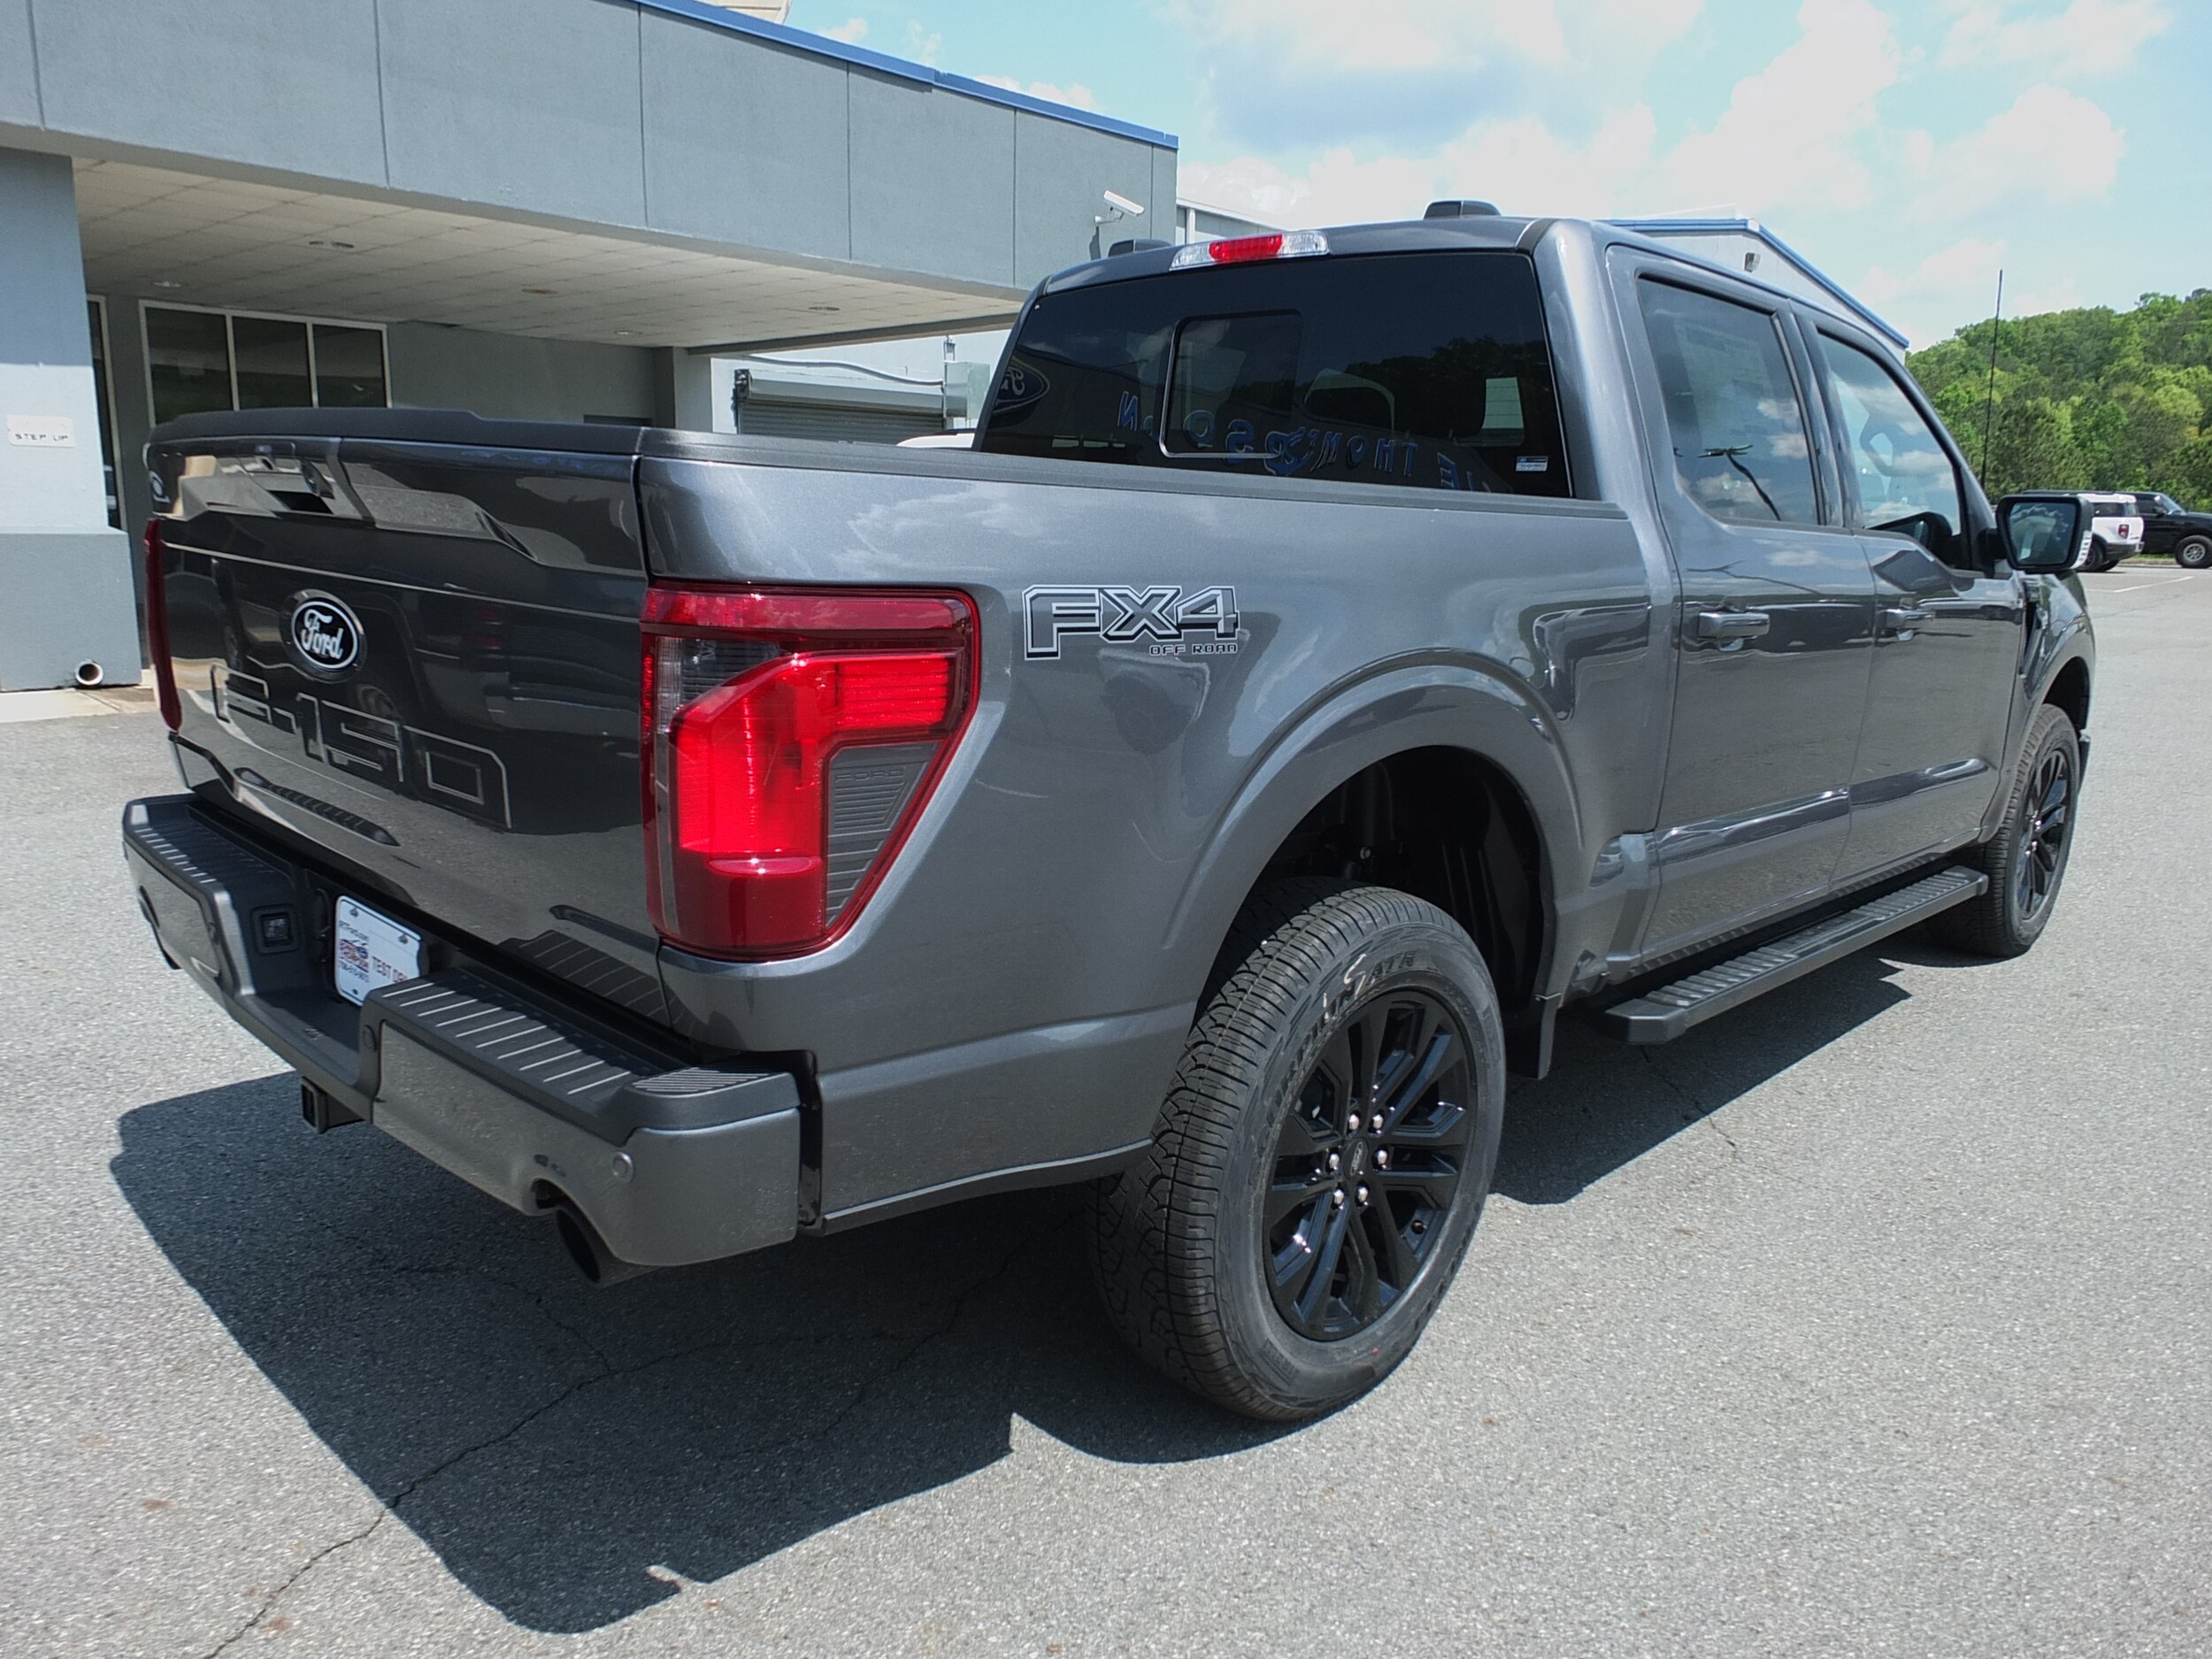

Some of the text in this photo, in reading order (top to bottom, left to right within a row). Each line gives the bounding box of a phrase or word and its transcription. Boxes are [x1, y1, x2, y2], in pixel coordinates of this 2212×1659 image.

[300, 609, 345, 660] Ford
[1022, 584, 1240, 660] FX4
[1149, 642, 1238, 657] OFF ROAD
[210, 664, 511, 830] F-150
[835, 769, 904, 783] FORD
[372, 956, 392, 979] TEST
